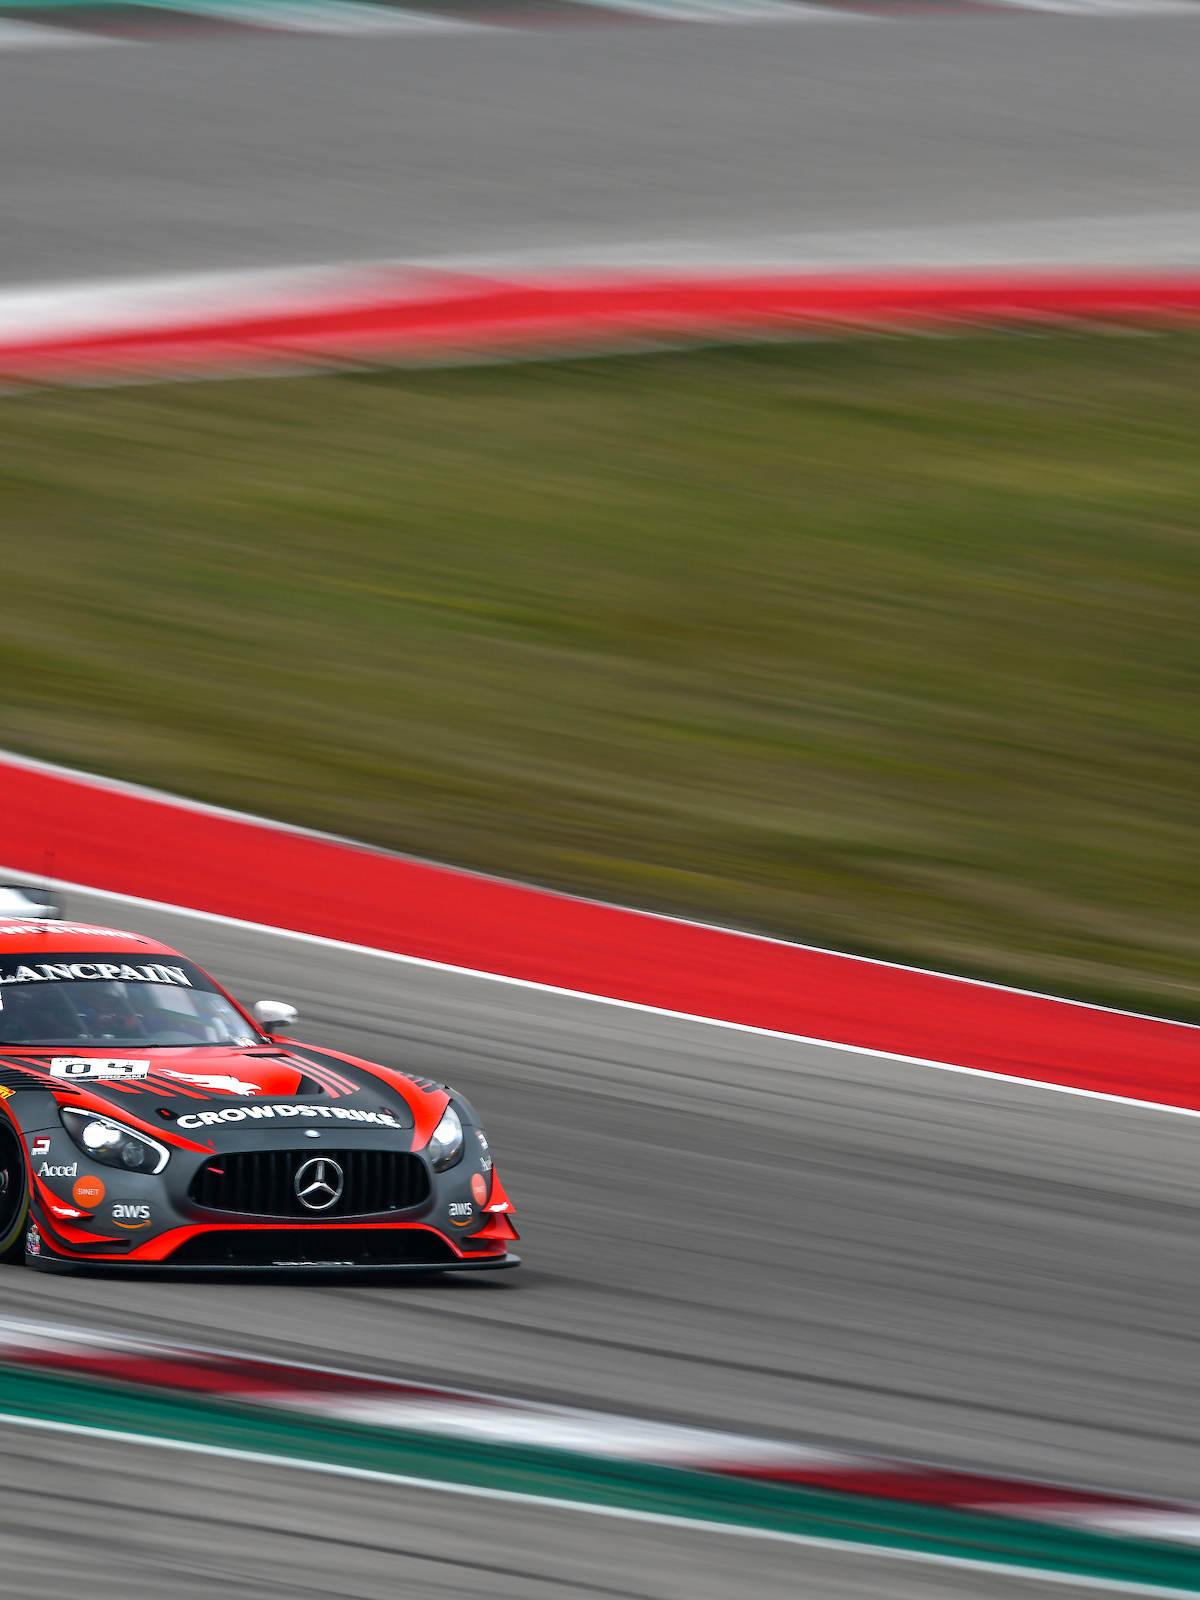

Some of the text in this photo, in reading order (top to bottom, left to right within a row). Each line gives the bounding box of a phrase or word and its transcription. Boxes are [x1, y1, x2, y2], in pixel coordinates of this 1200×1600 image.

[176, 1105, 402, 1128] CROWDSTRIKE
[37, 1162, 78, 1177] Accel
[112, 1204, 151, 1219] aws
[448, 1203, 473, 1216] aws
